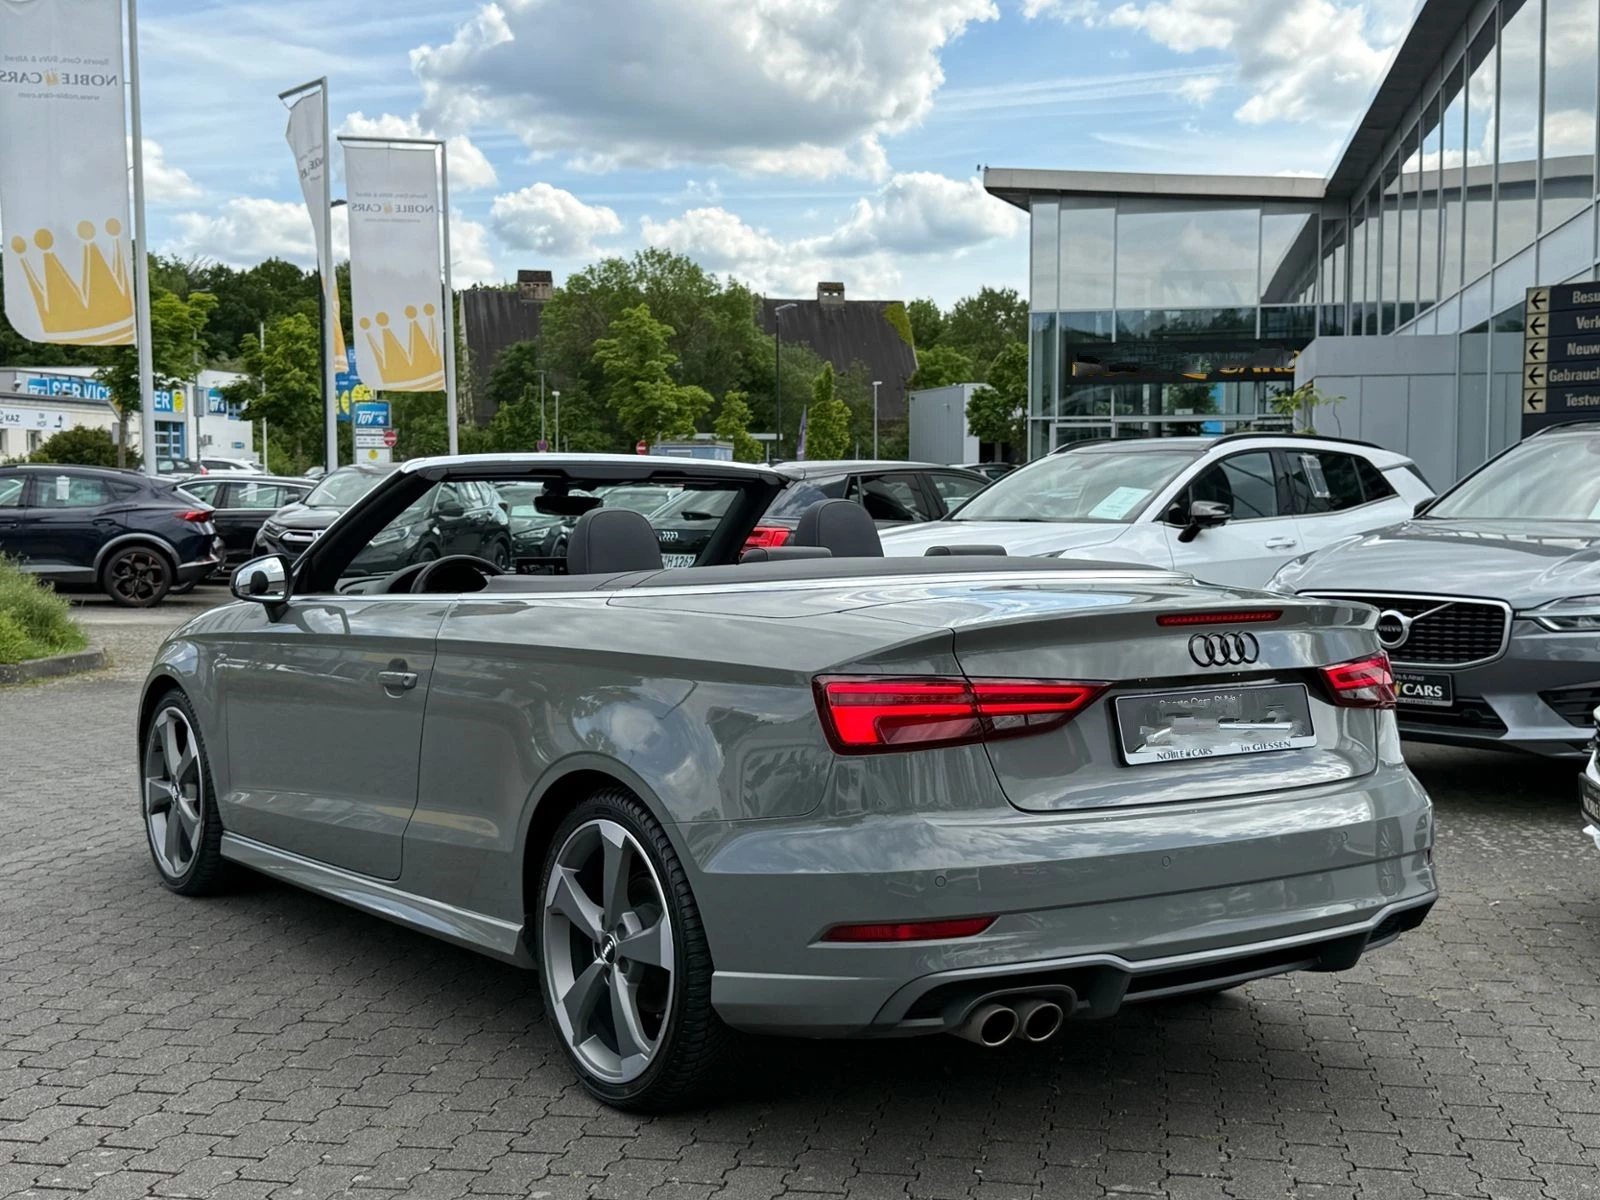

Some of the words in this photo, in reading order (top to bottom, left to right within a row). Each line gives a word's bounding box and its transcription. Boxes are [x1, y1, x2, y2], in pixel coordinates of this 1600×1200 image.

[1378, 625, 1402, 633] VOLVO
[1402, 683, 1443, 698] CARS
[1157, 750, 1186, 761] NOBLE
[1192, 748, 1214, 758] CARS
[1252, 741, 1292, 752] GIESSEN
